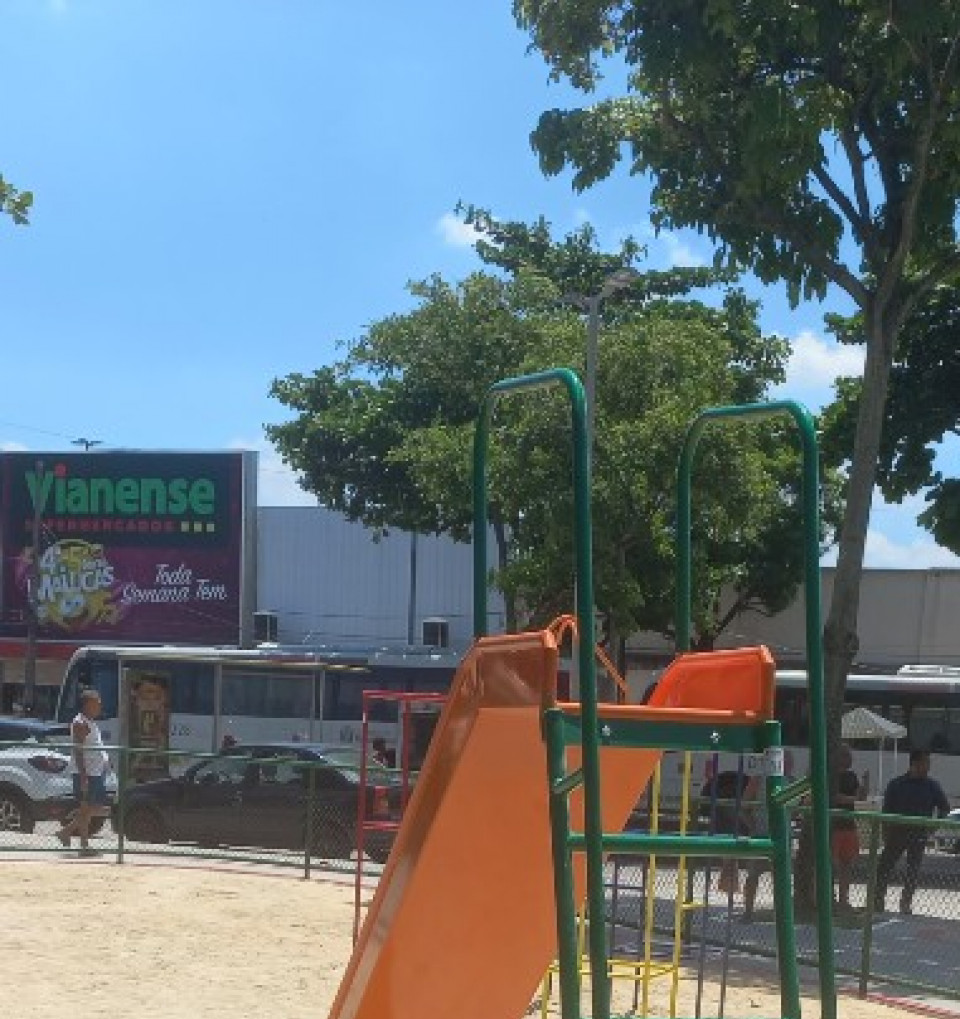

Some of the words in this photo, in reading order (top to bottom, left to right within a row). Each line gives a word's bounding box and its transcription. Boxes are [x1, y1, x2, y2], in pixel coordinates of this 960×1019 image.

[25, 463, 215, 515] Vianense
[155, 563, 192, 585] Toda
[121, 582, 190, 604] Semana
